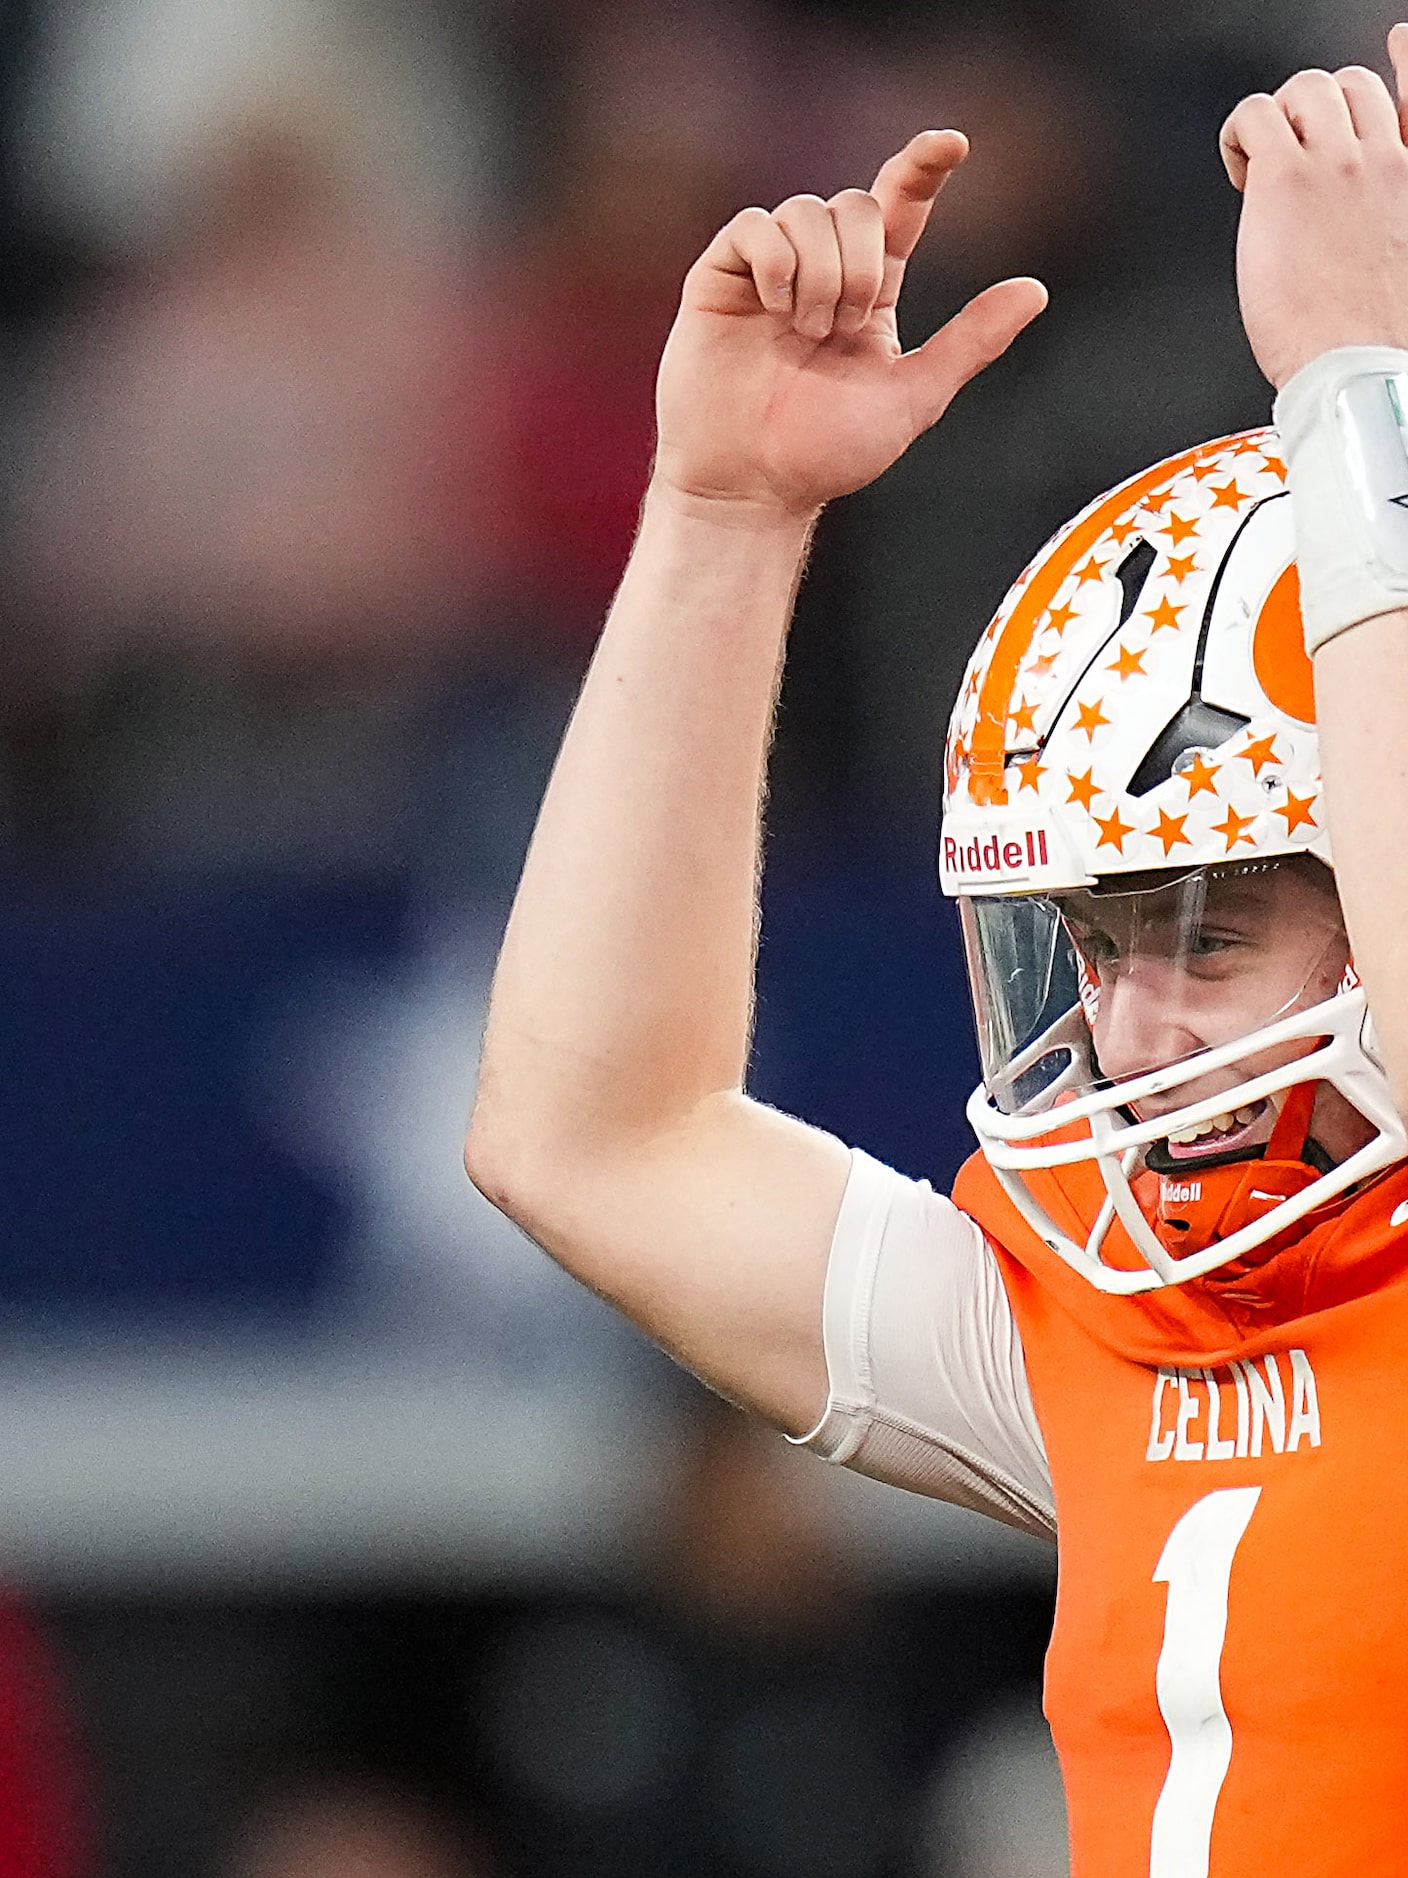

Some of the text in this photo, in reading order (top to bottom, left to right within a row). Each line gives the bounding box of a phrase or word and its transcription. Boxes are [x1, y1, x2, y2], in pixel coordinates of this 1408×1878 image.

[944, 829, 1048, 873] Riddell
[1146, 1349, 1322, 1462] CELINA
[1150, 1486, 1262, 1878] 1
